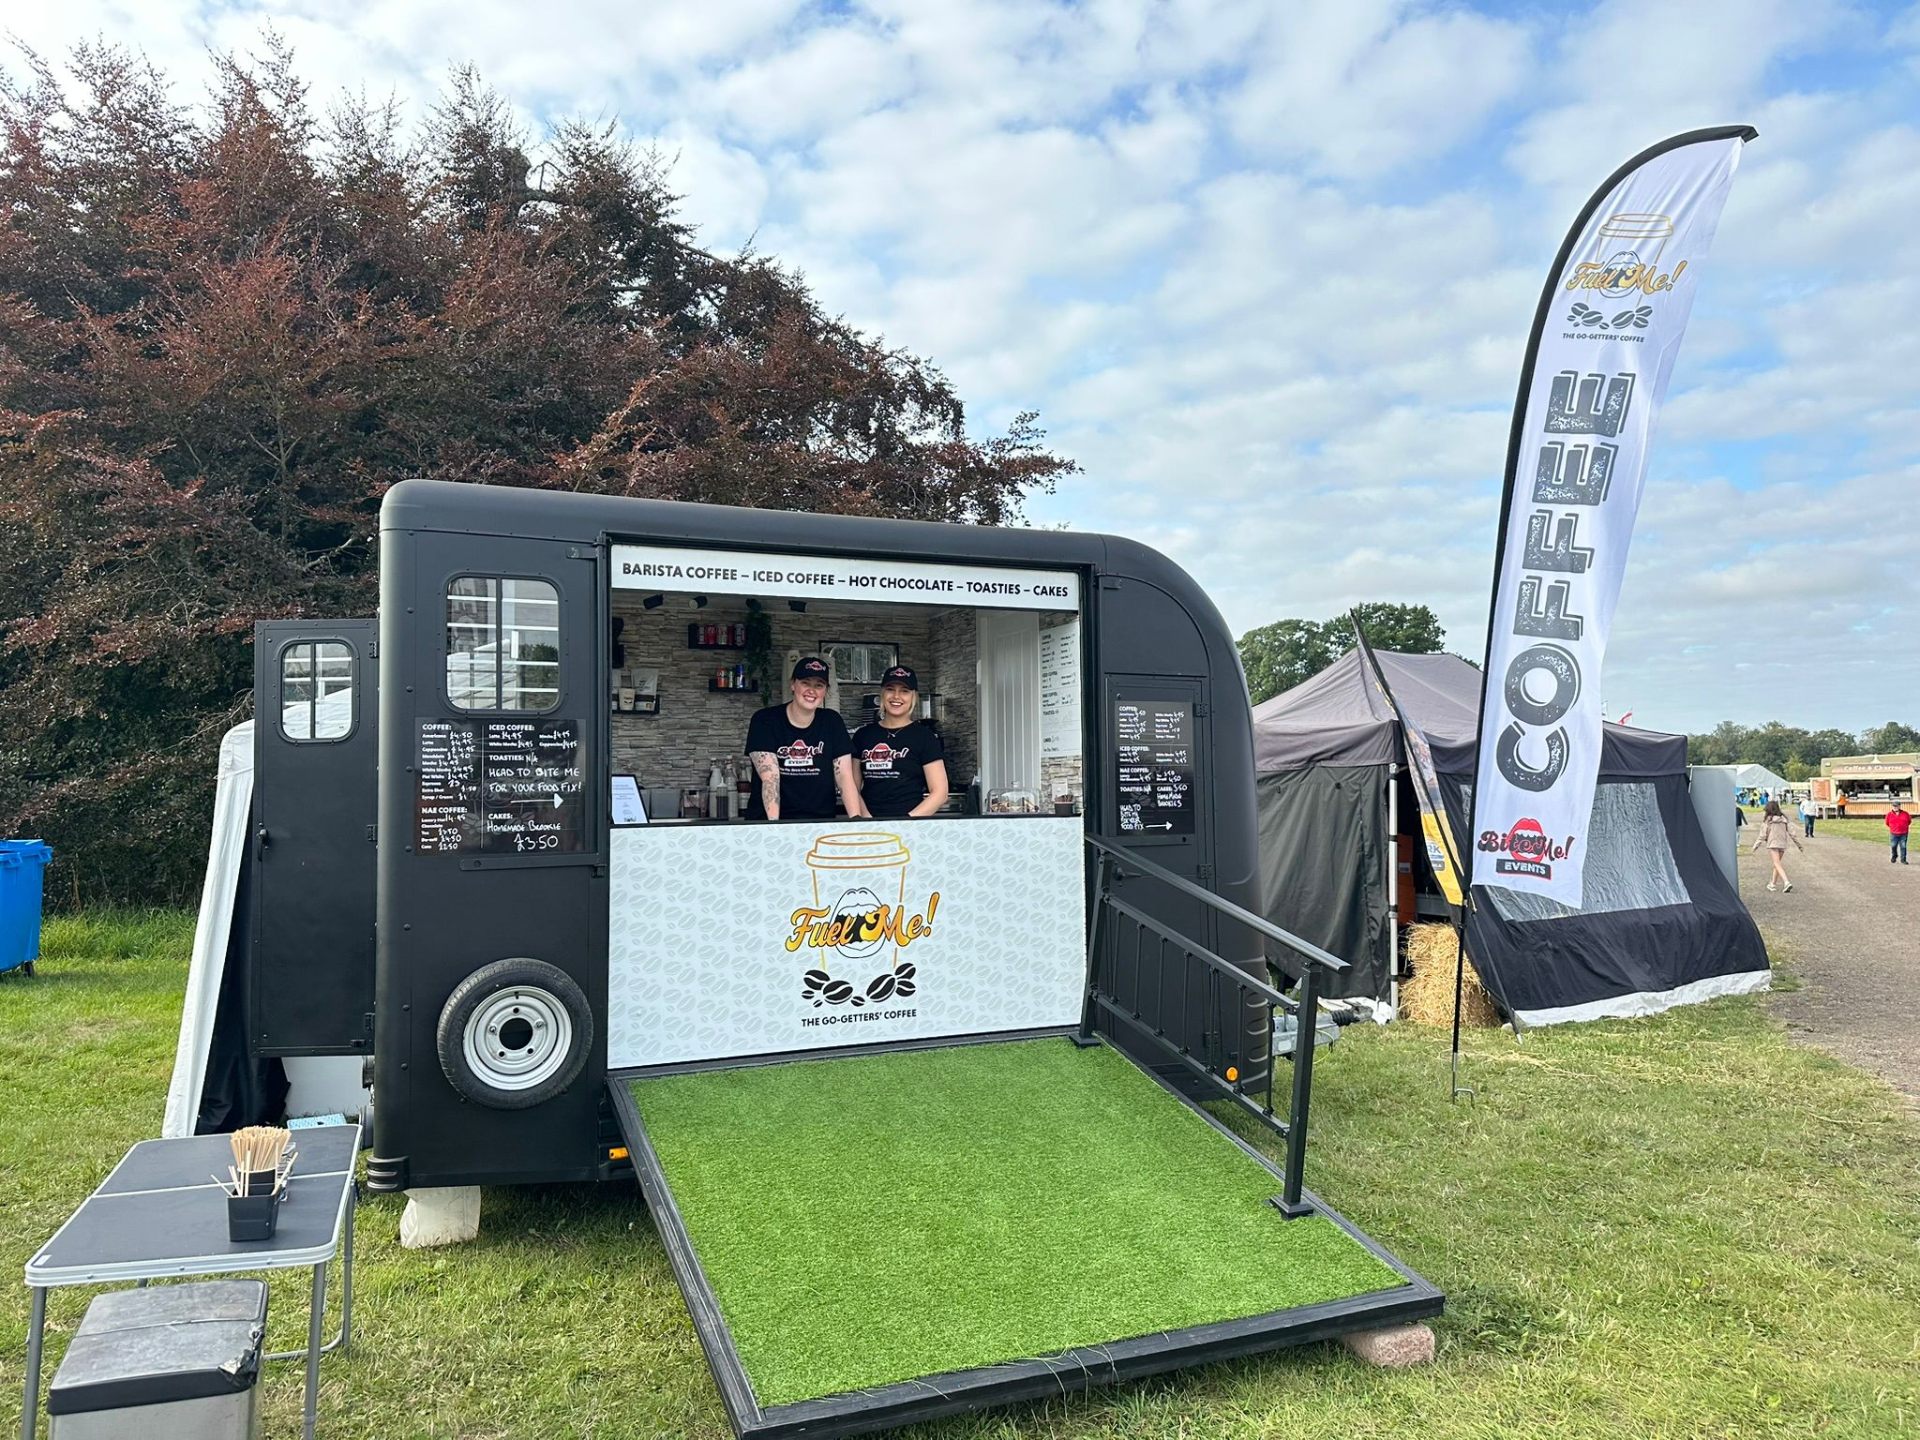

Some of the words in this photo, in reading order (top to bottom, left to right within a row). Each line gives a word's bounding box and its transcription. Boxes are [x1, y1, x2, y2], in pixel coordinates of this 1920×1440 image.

[1566, 260, 1617, 291] Fuel
[1618, 260, 1688, 295] Me!
[1562, 332, 1575, 340] THE
[1576, 332, 1620, 342] GO-GETTERS'
[1620, 335, 1645, 343] COFFEE
[622, 562, 683, 578] BARISTA
[686, 566, 738, 581] COFFEE
[753, 570, 783, 583] ICED
[786, 572, 835, 586] COFFEE
[849, 575, 877, 587] HOT
[879, 576, 954, 592] CHOCOLATE
[966, 581, 1021, 595] TOASTIES
[1033, 585, 1068, 597] CAKES
[1496, 370, 1637, 792] COFFEE
[422, 723, 452, 731] COFFEE:
[488, 767, 515, 778] HEAD
[516, 768, 531, 777] TO
[534, 767, 560, 777] BITE
[563, 767, 581, 777] ME
[488, 782, 508, 793] FOR
[511, 782, 535, 793] YOUR
[537, 781, 560, 793] FOOD
[560, 780, 582, 793] FIX!
[438, 806, 468, 814] COFFEE:
[488, 812, 514, 820] CAKES:
[513, 833, 559, 852] £3.50
[1477, 831, 1532, 854] Bite
[1532, 835, 1575, 862] Me!
[1504, 861, 1546, 875] EVENTS
[784, 904, 855, 952] Fuel
[859, 891, 941, 947] Me!
[801, 1017, 820, 1028] THE
[821, 1011, 883, 1026] GO-GETTERS'
[884, 1008, 917, 1020] COFFEE
